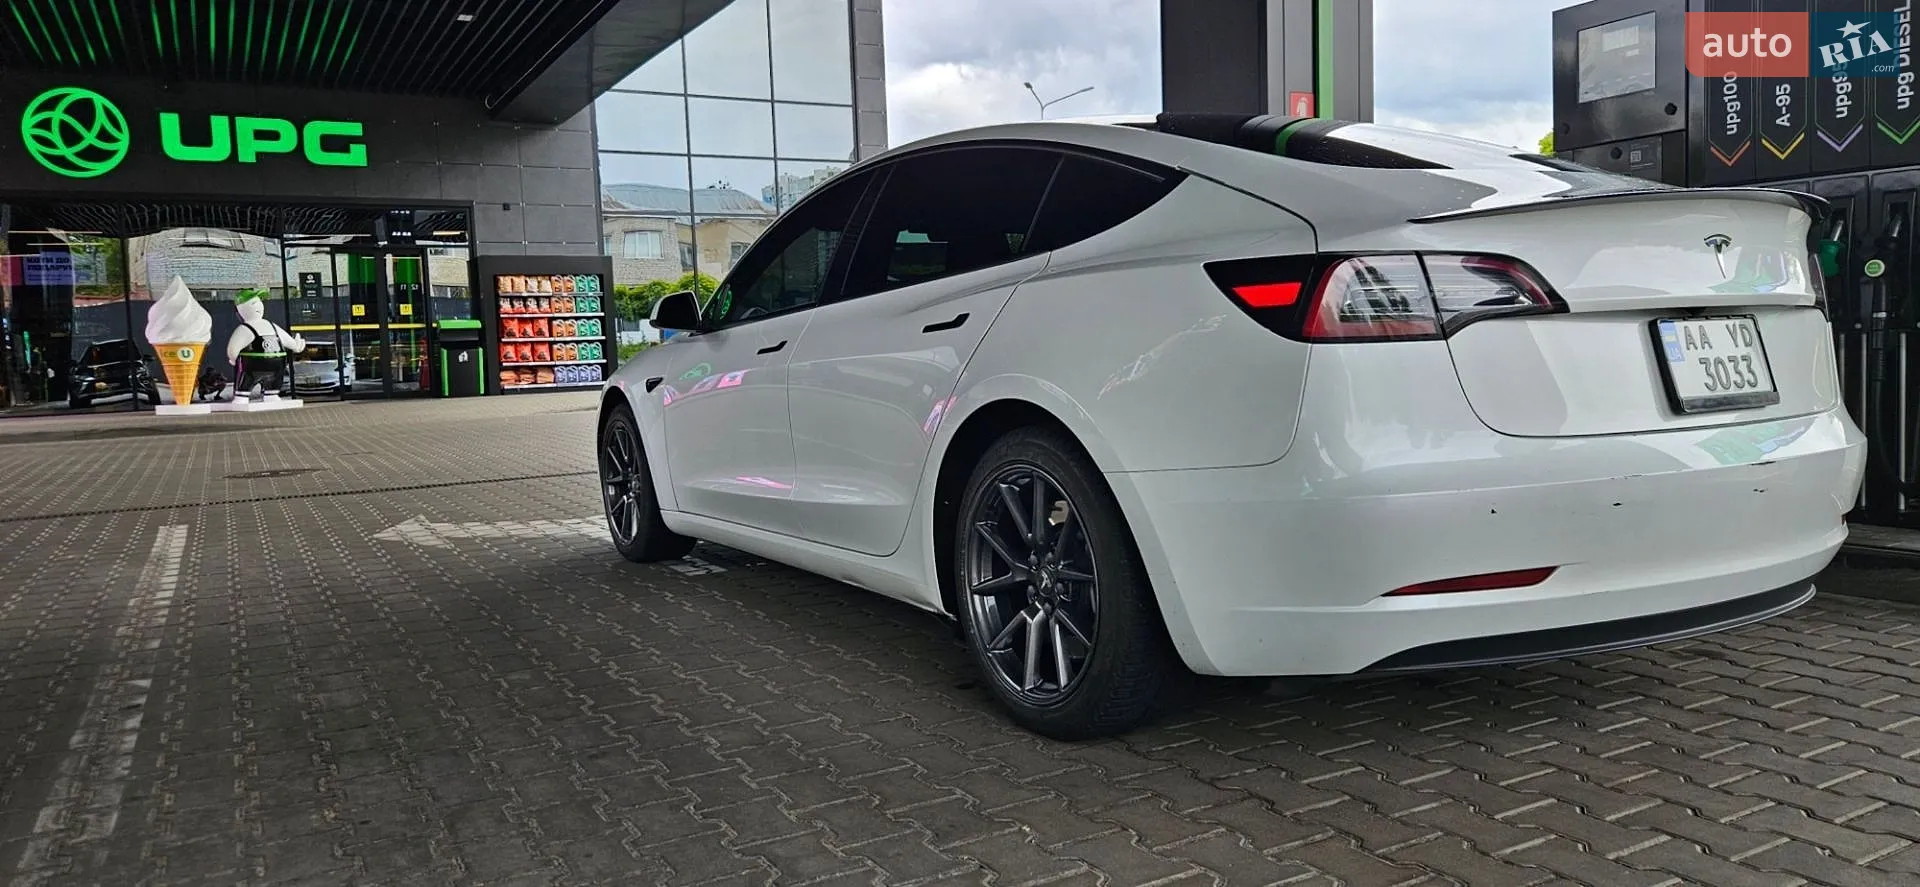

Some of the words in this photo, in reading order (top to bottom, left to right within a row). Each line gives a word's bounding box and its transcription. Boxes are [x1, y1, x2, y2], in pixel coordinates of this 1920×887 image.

[1893, 0, 1911, 67] DIESEL
[1723, 71, 1741, 135] upg100
[1775, 83, 1791, 127] A-95
[1832, 61, 1852, 119] upg95
[1897, 72, 1914, 109] upg
[159, 112, 368, 167] UPG
[1684, 325, 1713, 350] AA
[1725, 323, 1753, 348] YD
[1698, 355, 1758, 391] 3033
